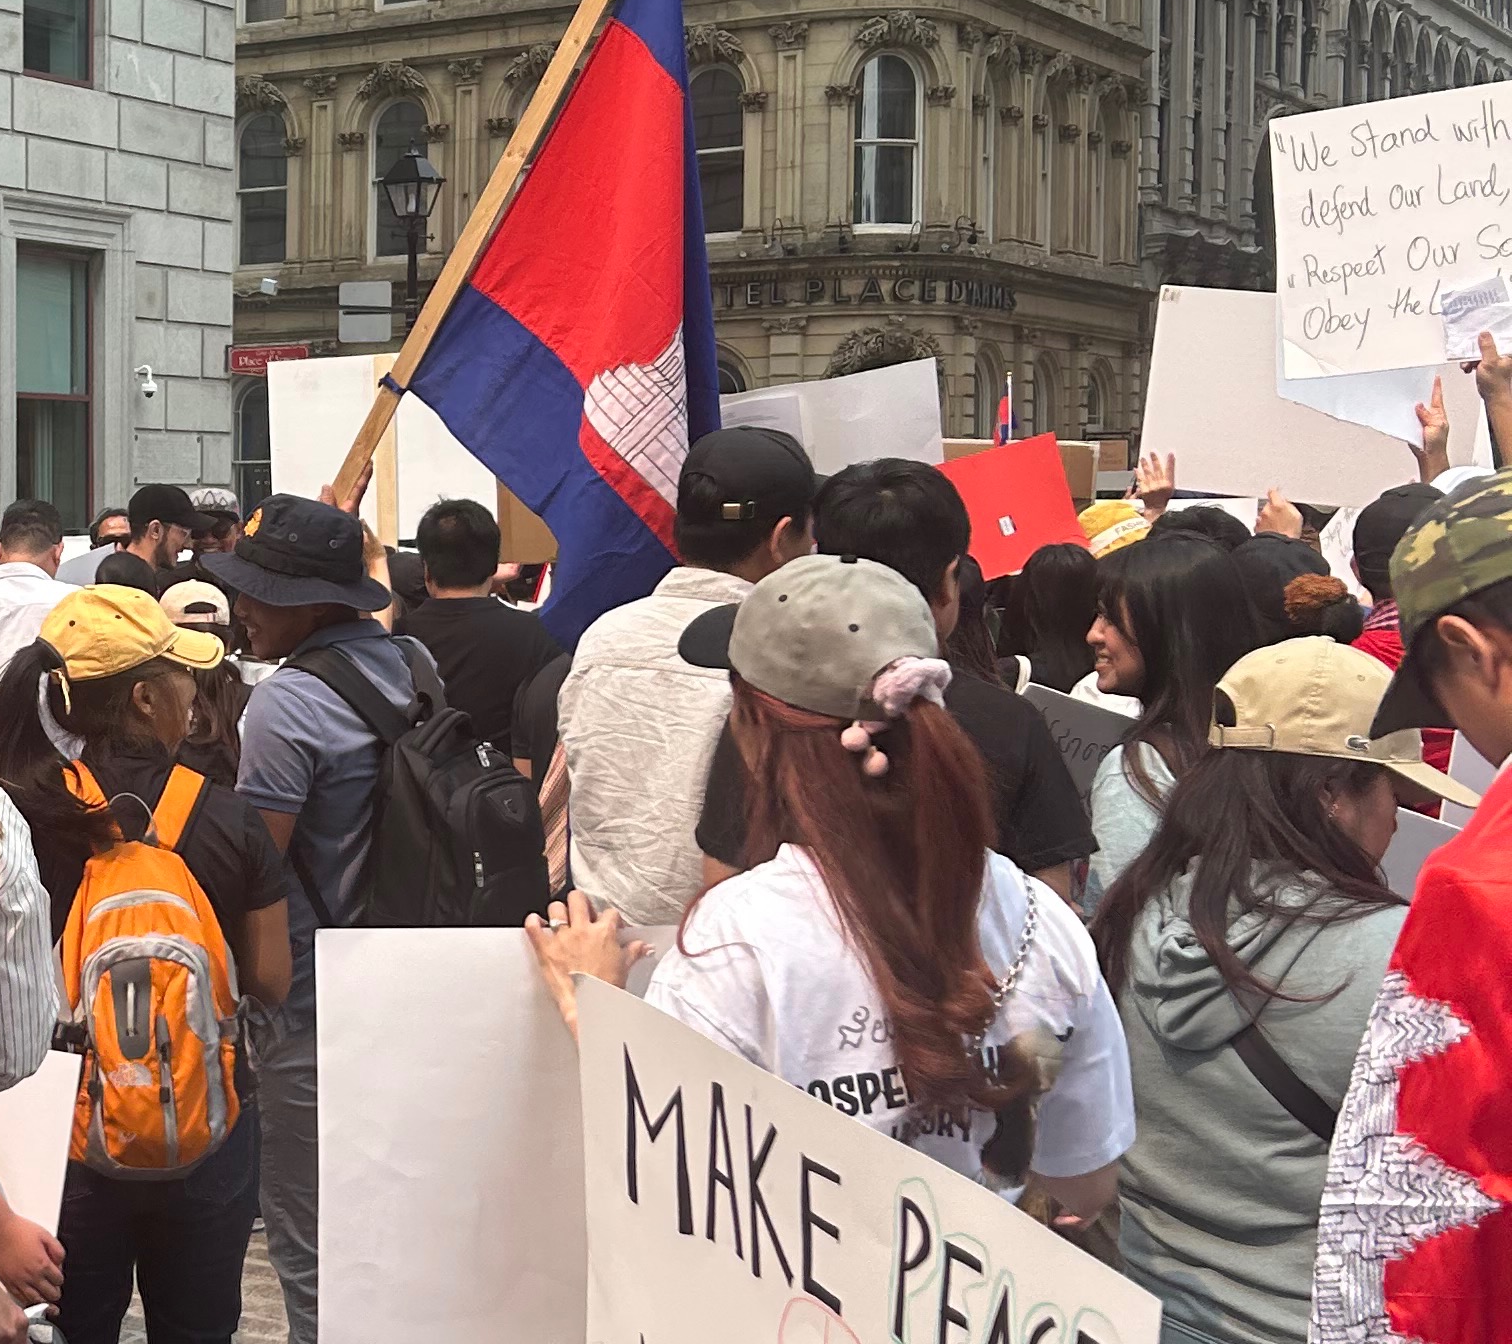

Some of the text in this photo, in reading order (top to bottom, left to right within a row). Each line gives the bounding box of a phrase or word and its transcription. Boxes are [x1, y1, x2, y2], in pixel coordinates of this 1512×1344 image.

[1453, 99, 1511, 149] with
[1301, 184, 1378, 235] defend
[1406, 236, 1461, 272] Our
[721, 281, 787, 307] TEL
[804, 276, 938, 304] PLACE
[1302, 298, 1371, 351] Obey
[1388, 287, 1425, 319] the
[623, 1041, 842, 1316] MAKE
